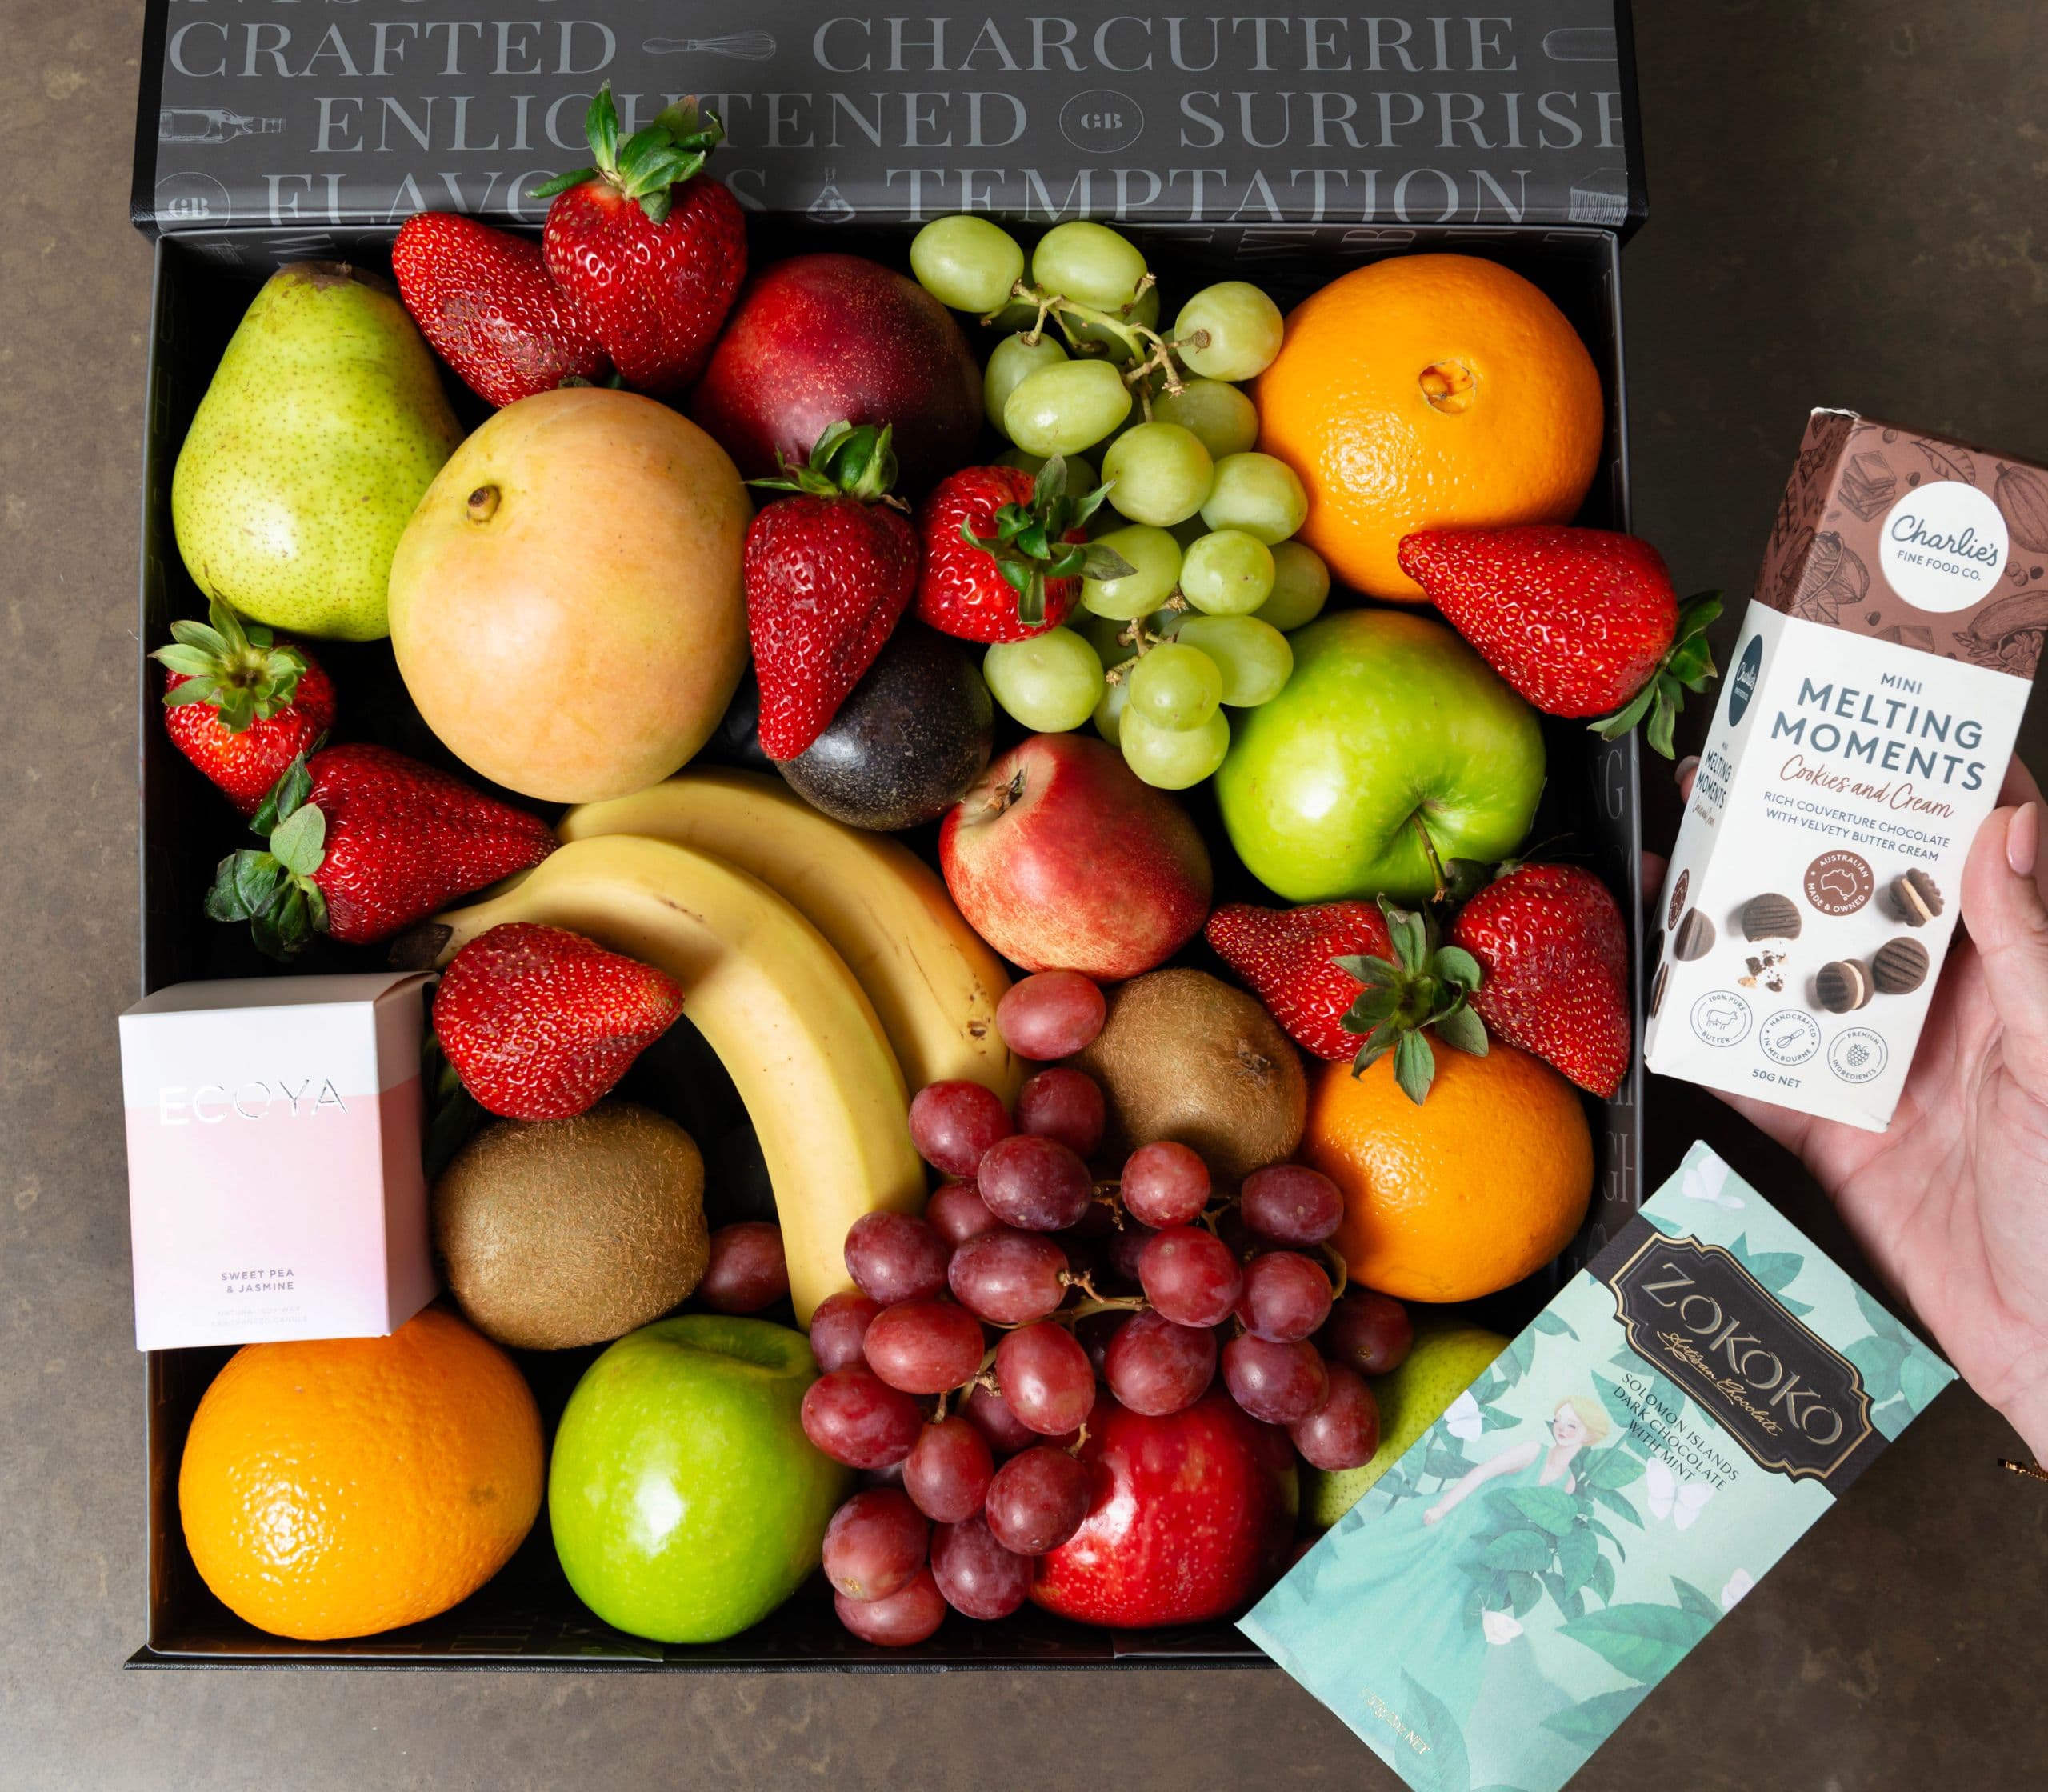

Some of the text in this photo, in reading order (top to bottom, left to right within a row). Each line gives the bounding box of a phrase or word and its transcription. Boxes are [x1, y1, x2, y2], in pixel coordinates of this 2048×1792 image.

[168, 16, 1518, 78] CRAFTED CHARCUTERIE
[262, 168, 768, 226] FLAVOS
[886, 168, 1532, 223] TEMPTATION
[1891, 514, 1998, 566] Charlie's
[1897, 550, 1982, 581] FINE FOOD CO.
[1880, 672, 1922, 694] MINI
[1797, 677, 1983, 750] MELTING
[1770, 711, 1986, 790] MOMENTS
[1779, 754, 1954, 818] Cookies and Cream
[1763, 791, 1950, 848] RICH COUVERTURE CHOCOLATE
[1766, 807, 1939, 862] WITH VELVETY BUTTER CREAM
[1819, 854, 1869, 878] AUSTRALIAN
[1808, 882, 1824, 906] MADE
[1833, 894, 1865, 912] OWNED
[1708, 994, 1746, 1011] 100% PURE
[1770, 1014, 1817, 1038] HANDCRAFTED
[1702, 1031, 1730, 1044] BUTTER
[1763, 1038, 1811, 1062] IN MELBOURNE
[1847, 1031, 1880, 1046] PREMIUM
[1752, 1068, 1802, 1089] 50G NET
[1833, 1059, 1877, 1080] INGREDIENTS
[159, 1078, 348, 1126] ECOYA
[221, 1268, 294, 1281] SWEET PEA
[238, 1281, 294, 1293] JASMINE
[1641, 1262, 1842, 1445] ZOKOKO
[1657, 1330, 1783, 1437] Artisan Chocolate
[1613, 1386, 1727, 1491] DARK CHOCOLATE
[1622, 1373, 1739, 1481] SOLOMON ISLANDS
[1629, 1419, 1695, 1481] WITH MINT
